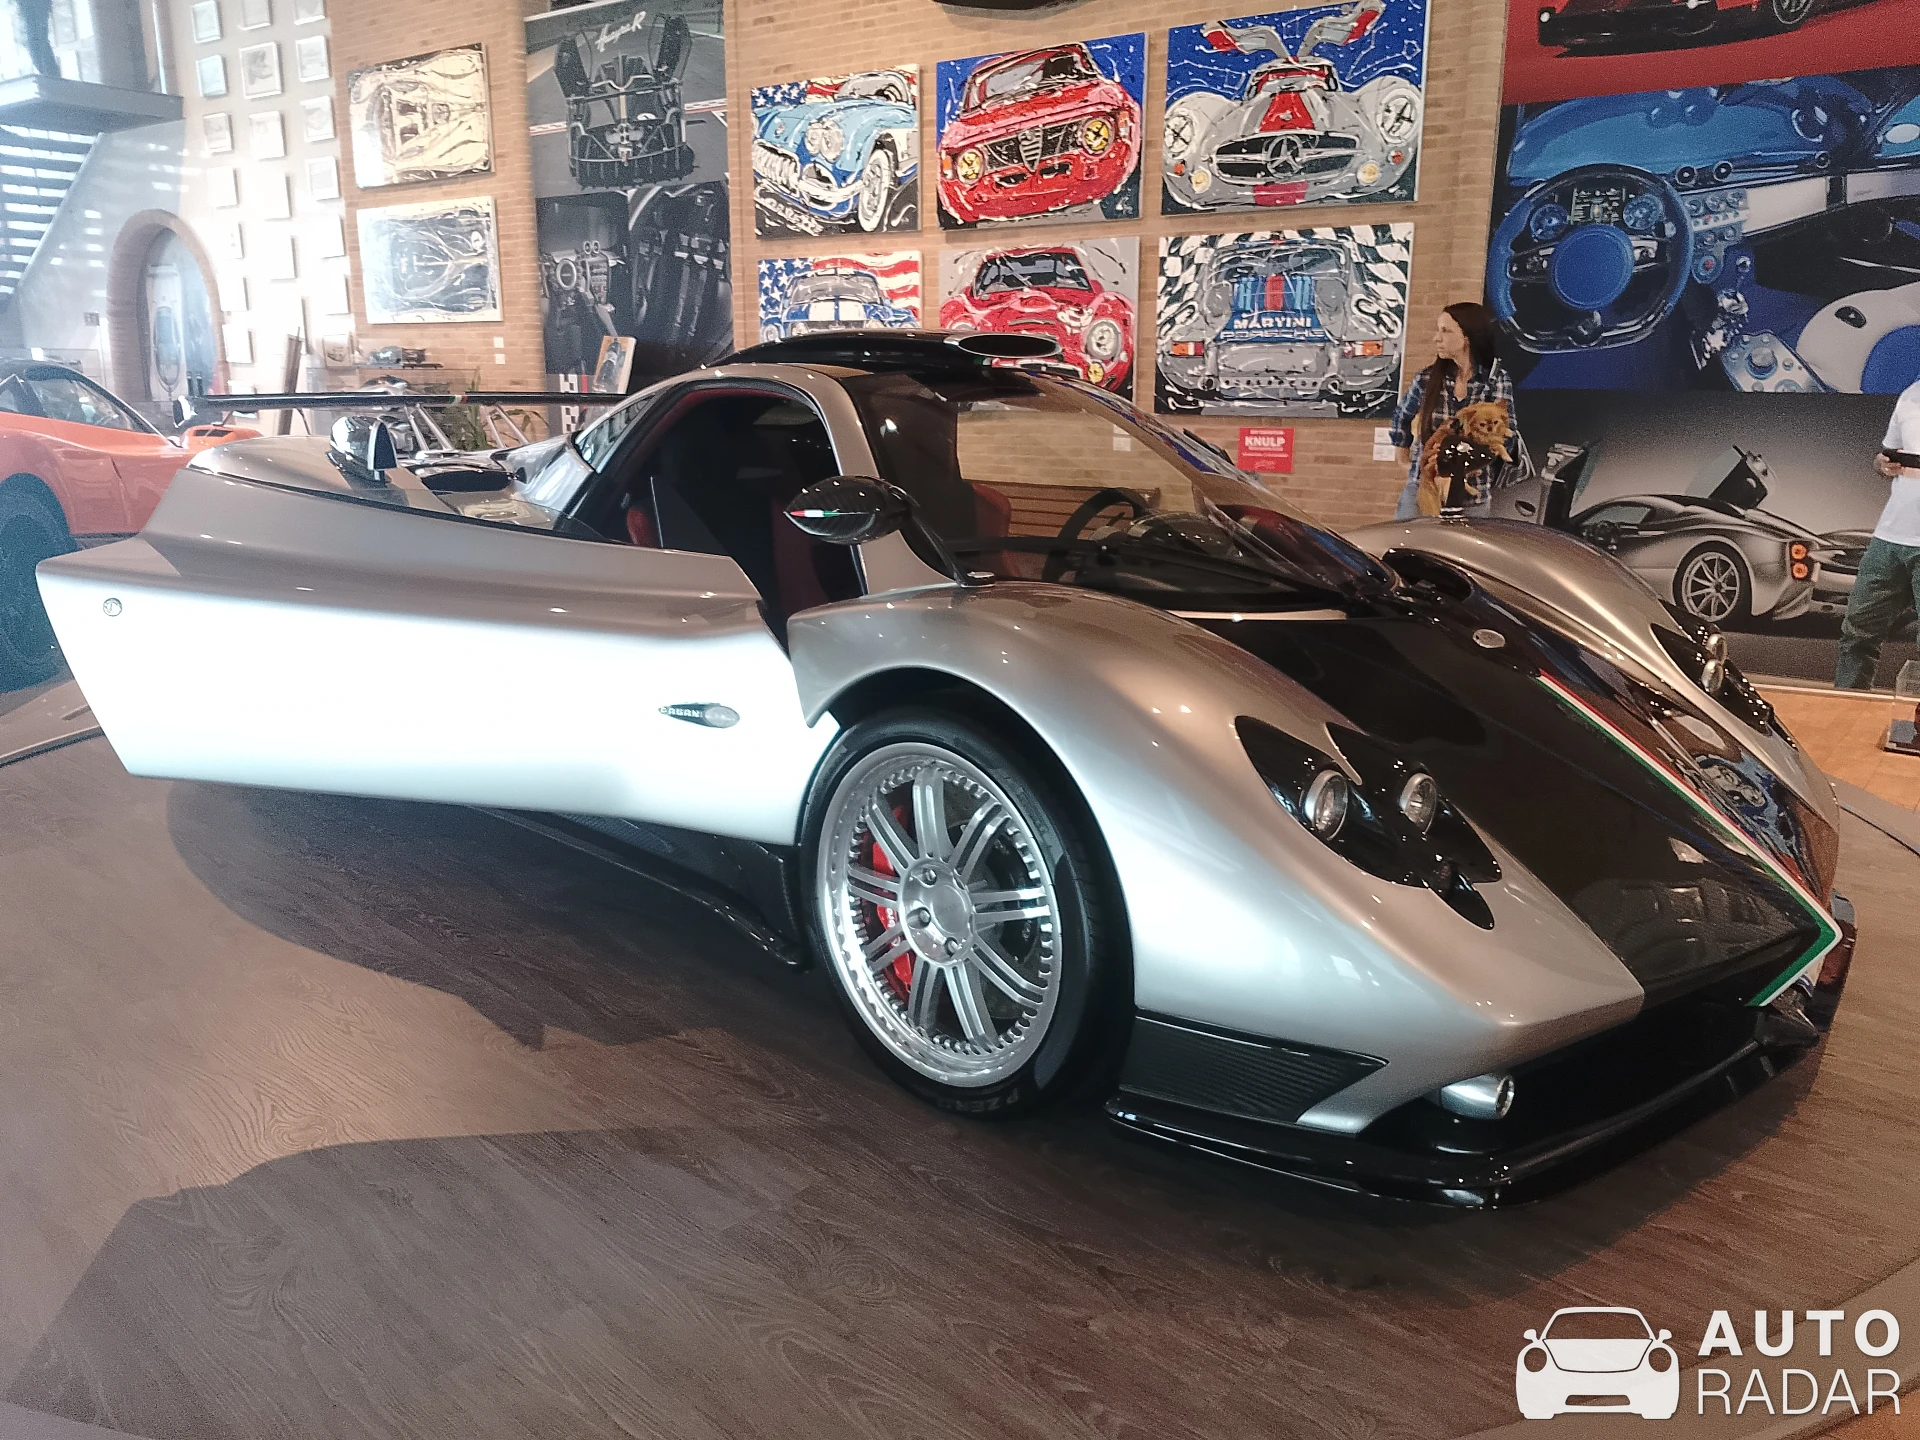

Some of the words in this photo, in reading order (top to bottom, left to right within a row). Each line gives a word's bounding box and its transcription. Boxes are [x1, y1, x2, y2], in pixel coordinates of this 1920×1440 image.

[1233, 316, 1312, 329] MARTINI
[1220, 328, 1326, 340] PORSCHE
[1244, 435, 1286, 447] KNULP
